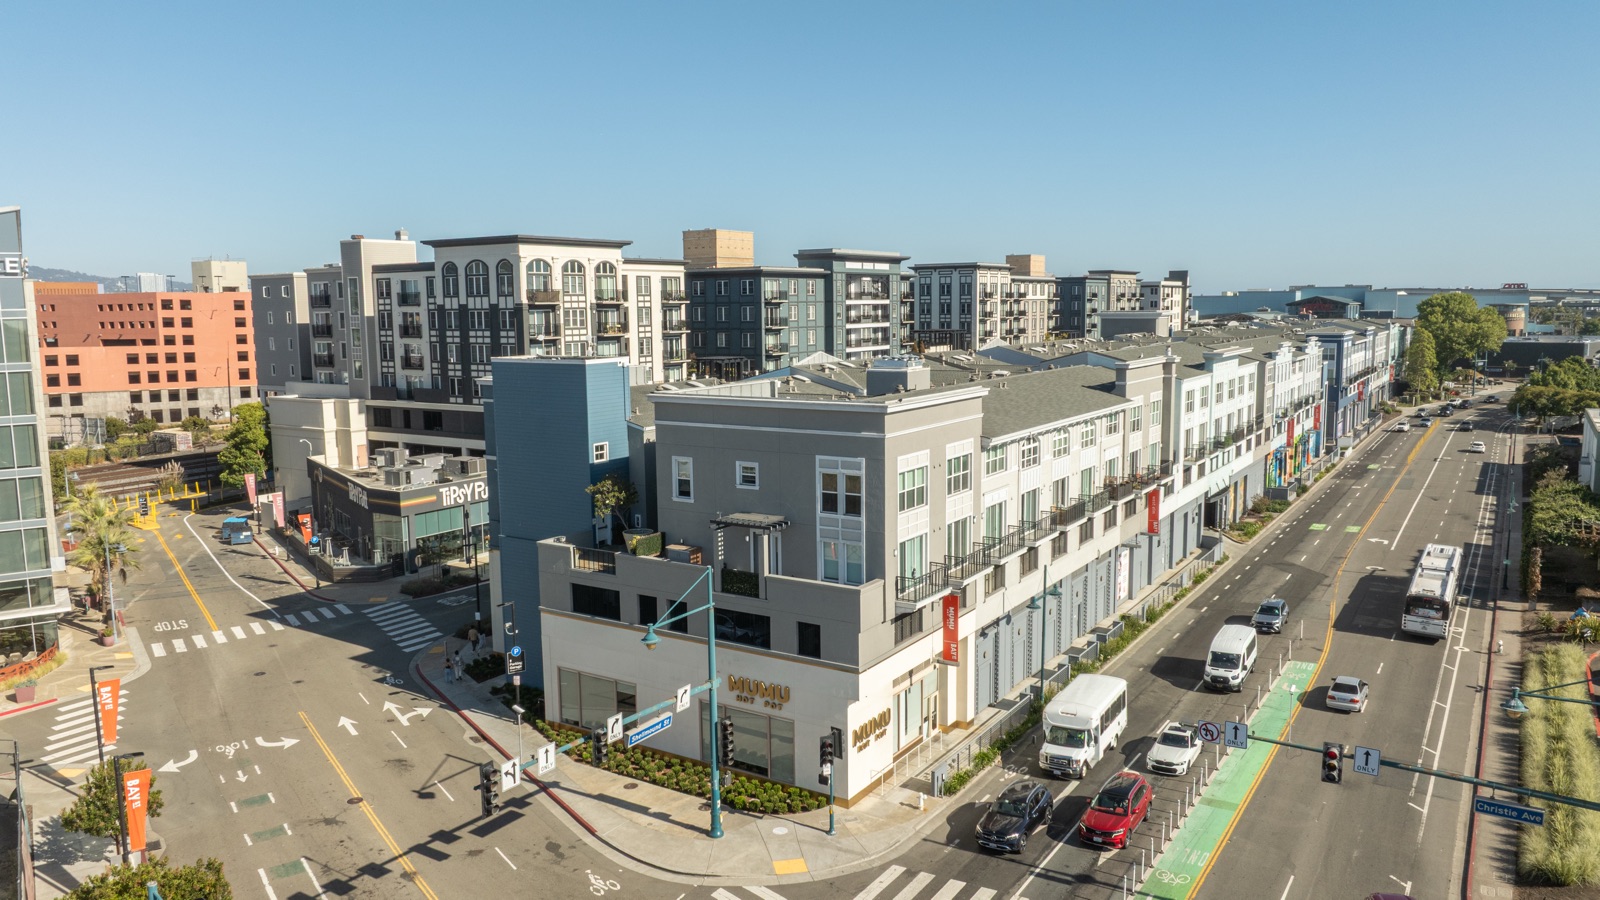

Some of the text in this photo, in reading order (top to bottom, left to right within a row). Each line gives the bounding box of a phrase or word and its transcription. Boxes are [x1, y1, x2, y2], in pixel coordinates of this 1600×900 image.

[154, 619, 189, 632] STOP
[100, 686, 113, 705] BAY
[728, 674, 790, 704] MUMU
[678, 701, 689, 710] ONLY
[736, 694, 784, 711] HOT POT
[609, 731, 622, 741] ONLY
[631, 718, 671, 743] Shellmound St
[852, 707, 891, 748] MUMU
[1226, 738, 1245, 748] ONLY
[540, 762, 554, 772] ONLY
[1356, 764, 1376, 774] ONLY
[126, 778, 140, 802] BAY
[1477, 802, 1542, 823] Christie Ave
